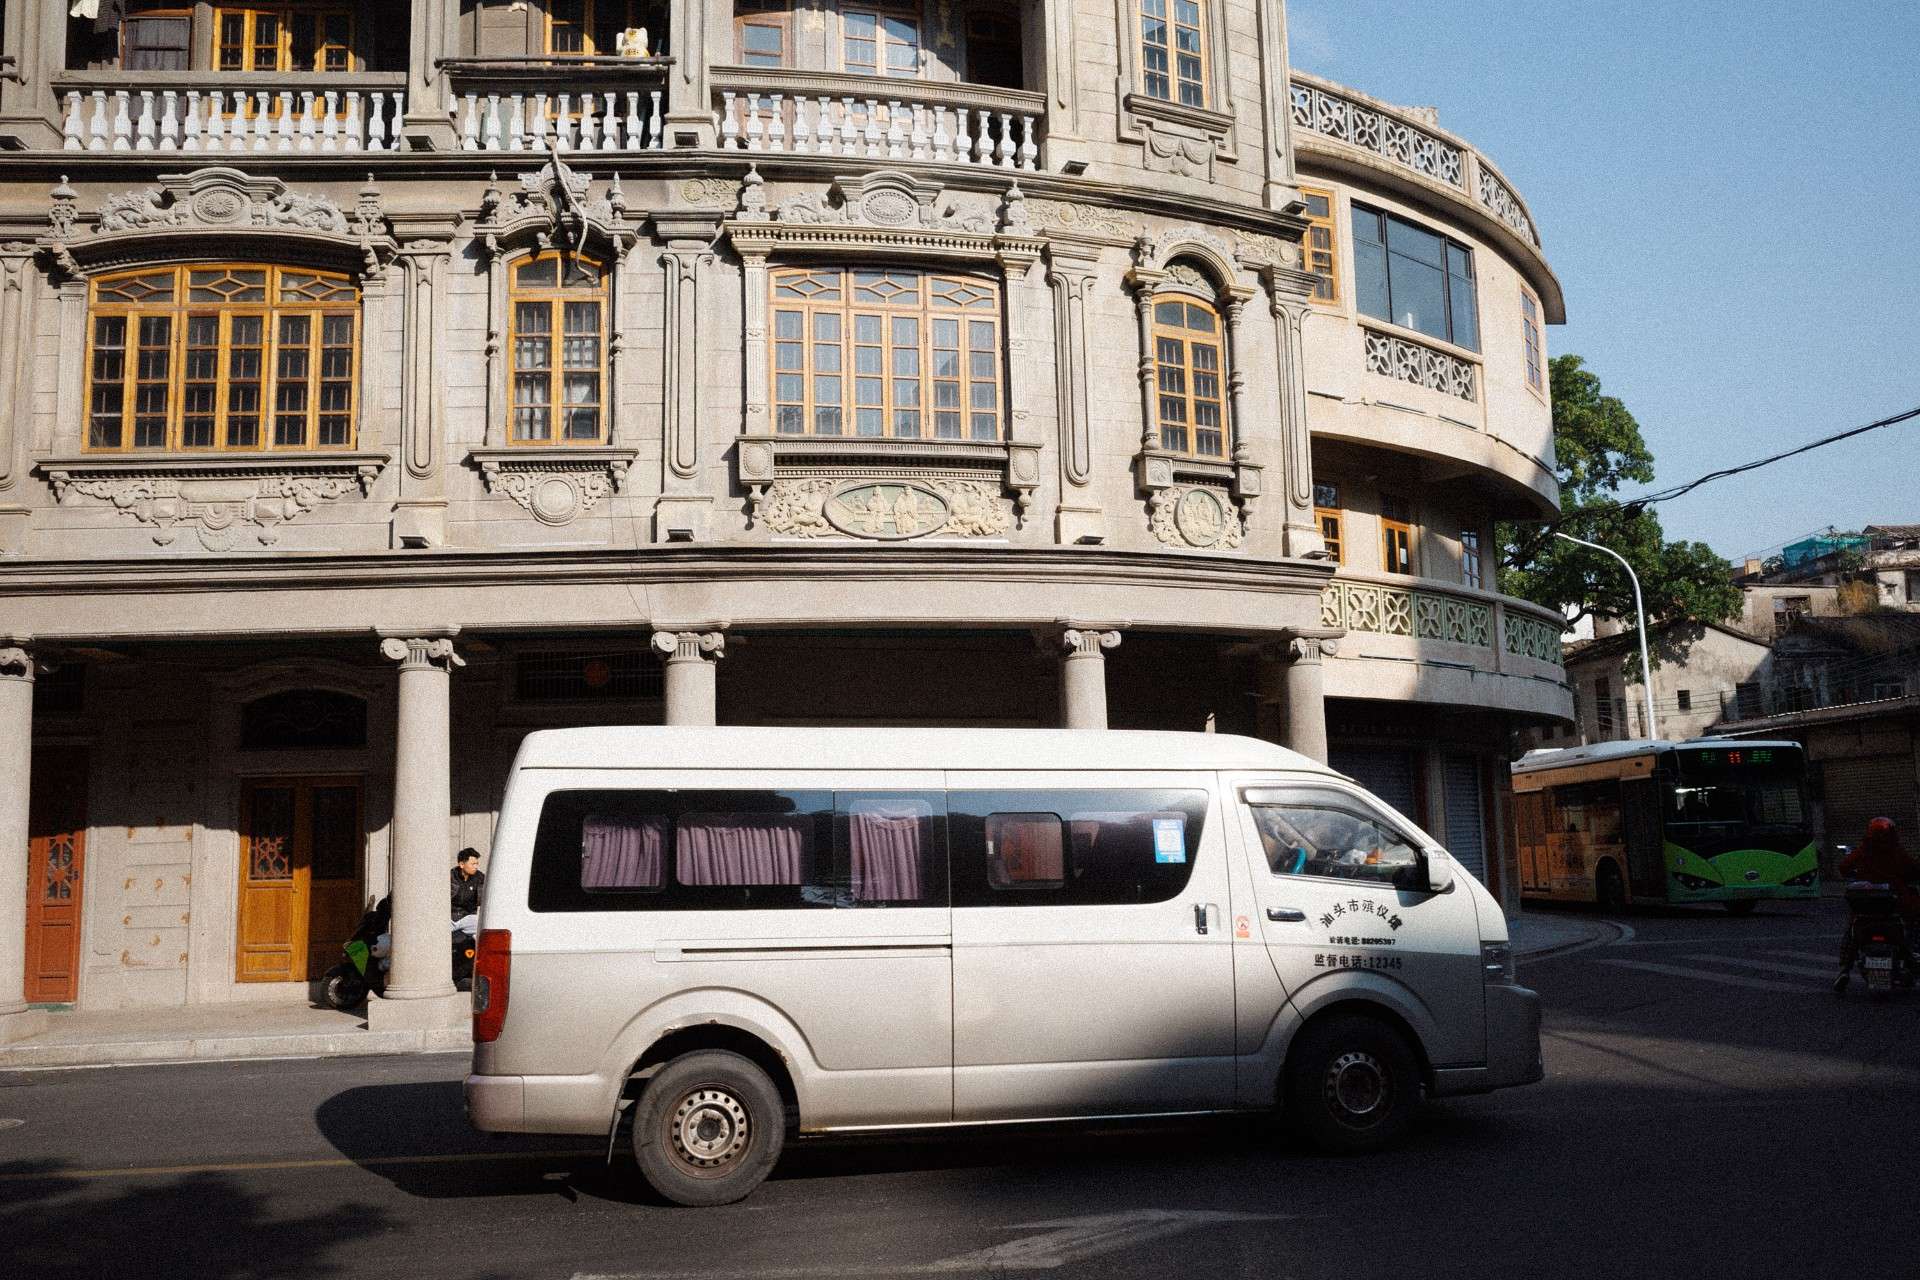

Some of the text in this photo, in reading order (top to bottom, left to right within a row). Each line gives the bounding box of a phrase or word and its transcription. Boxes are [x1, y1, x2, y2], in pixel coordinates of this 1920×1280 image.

[1320, 899, 1403, 931] 汕头市殡仪馆
[1314, 954, 1402, 969] 监督电话:12345
